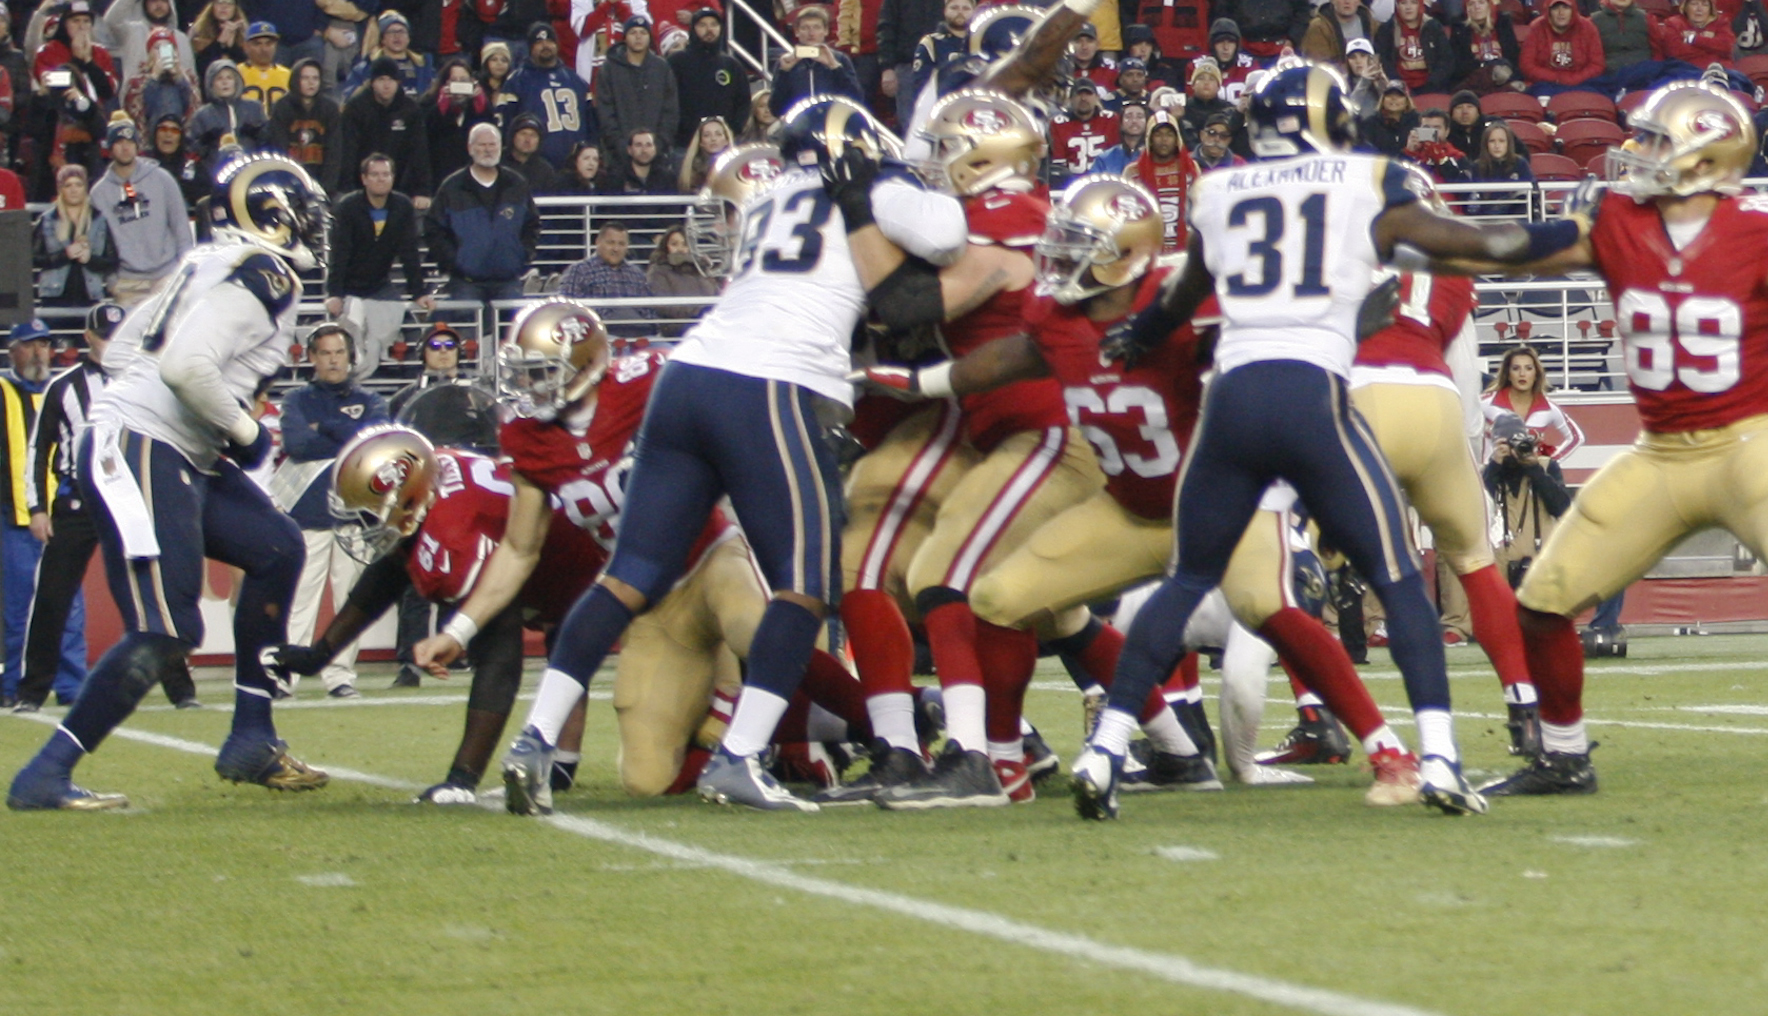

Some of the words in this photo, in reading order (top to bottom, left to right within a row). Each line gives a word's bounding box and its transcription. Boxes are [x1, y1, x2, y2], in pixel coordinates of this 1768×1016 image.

[541, 88, 581, 132] 13
[738, 187, 834, 274] 93
[1226, 193, 1330, 298] 31
[1618, 287, 1741, 393] 89
[1063, 387, 1180, 478] 63
